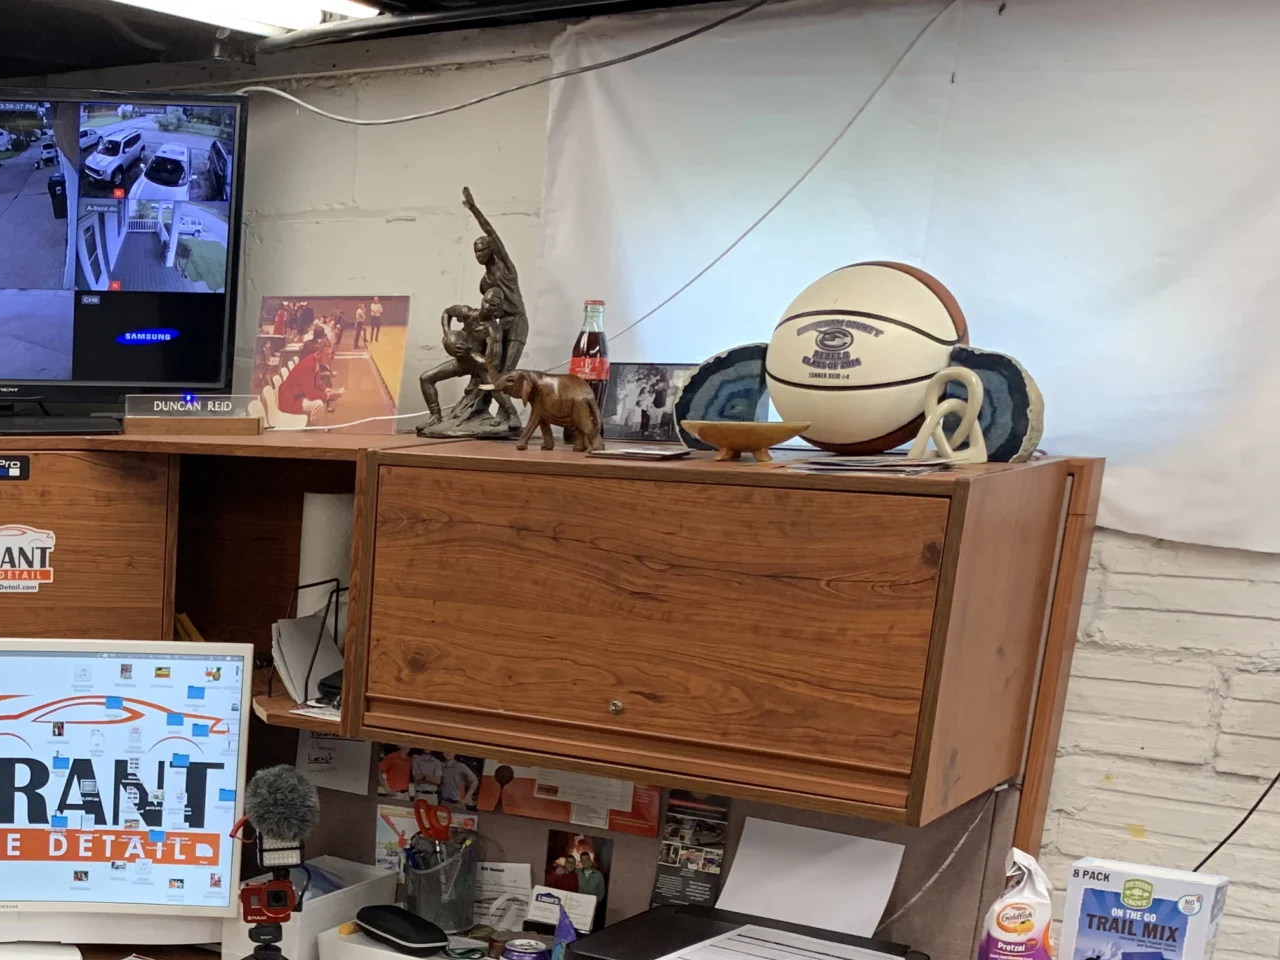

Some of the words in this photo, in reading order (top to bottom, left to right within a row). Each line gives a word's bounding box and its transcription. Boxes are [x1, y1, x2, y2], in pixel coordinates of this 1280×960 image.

[125, 332, 171, 341] SAMSUNG
[813, 350, 851, 360] REBELS
[153, 400, 202, 411] DUNCAN
[208, 401, 232, 412] REID
[48, 834, 186, 860] DETAIL
[1072, 868, 1080, 878] 8
[1082, 870, 1111, 883] PACK
[1002, 912, 1033, 923] Goldfish
[1111, 908, 1124, 918] ON
[1126, 910, 1142, 920] THE
[1144, 913, 1157, 923] GO
[1086, 913, 1137, 937] TRAIL
[1141, 923, 1180, 944] MIX
[998, 942, 1026, 952] Pretzel
